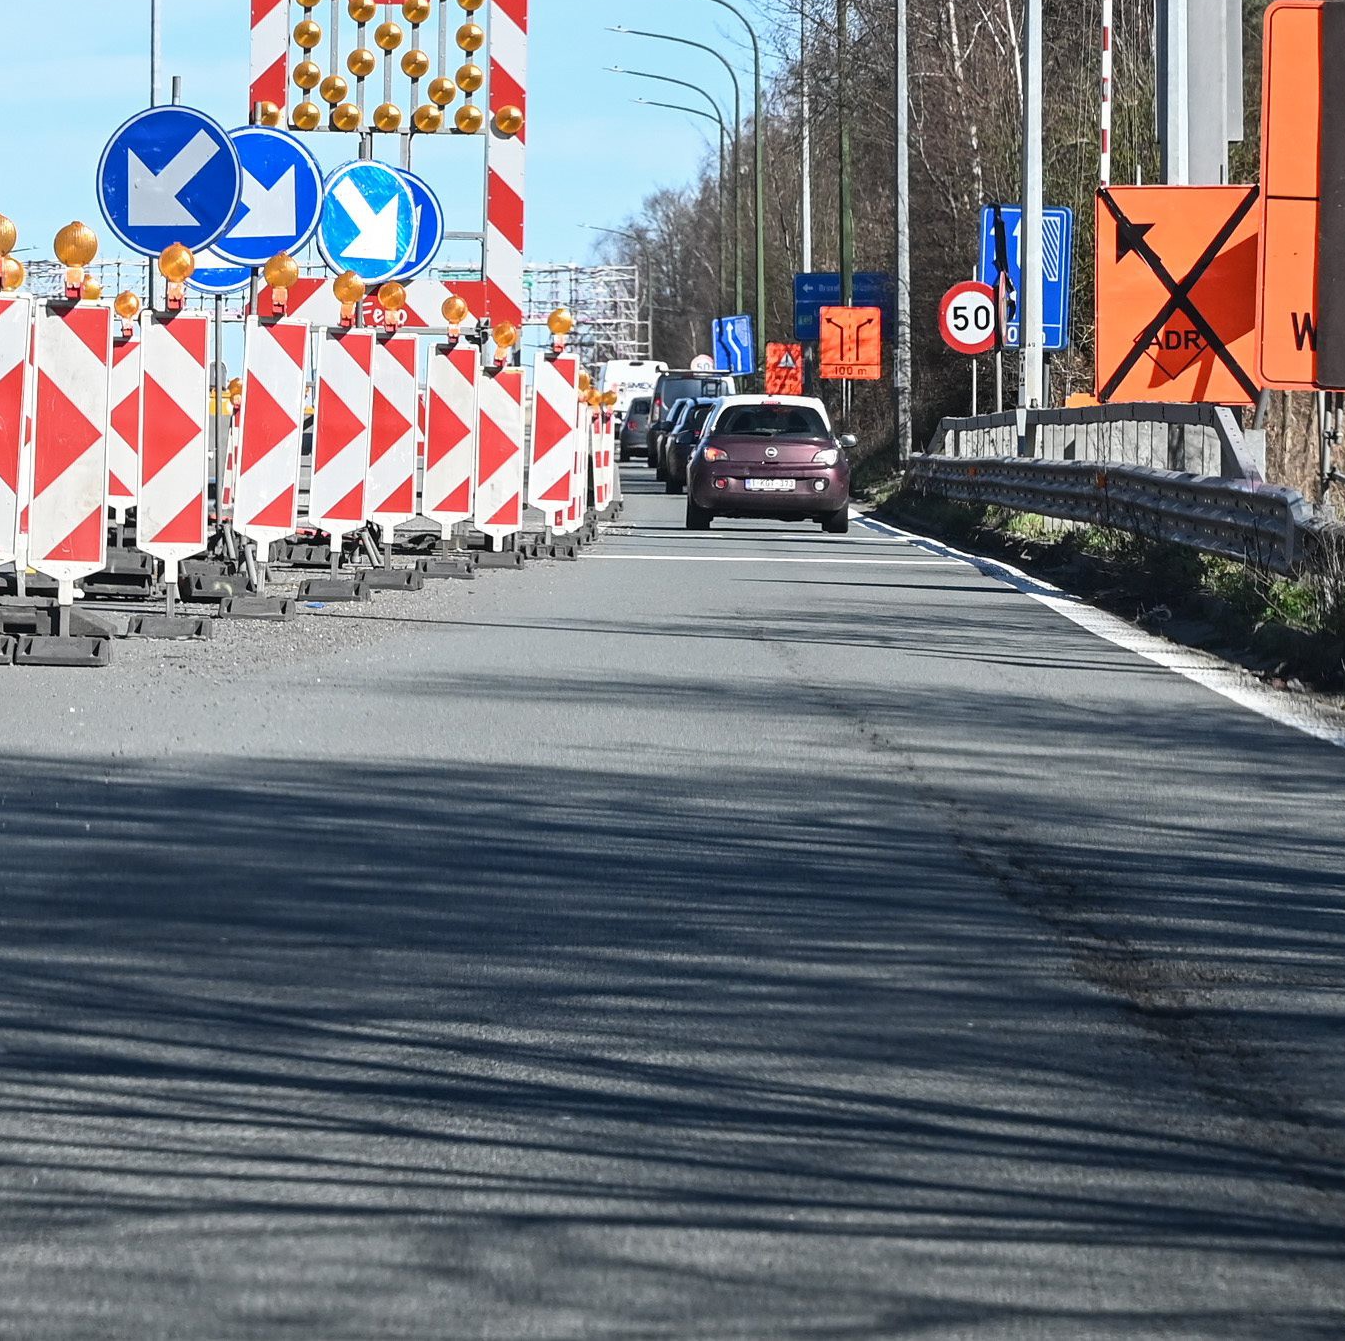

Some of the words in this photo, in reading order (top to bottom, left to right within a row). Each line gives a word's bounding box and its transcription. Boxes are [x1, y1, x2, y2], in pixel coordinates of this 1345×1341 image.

[362, 301, 408, 325] Feo
[953, 305, 991, 331] 50
[1145, 329, 1203, 351] ADR
[835, 366, 853, 376] 100
